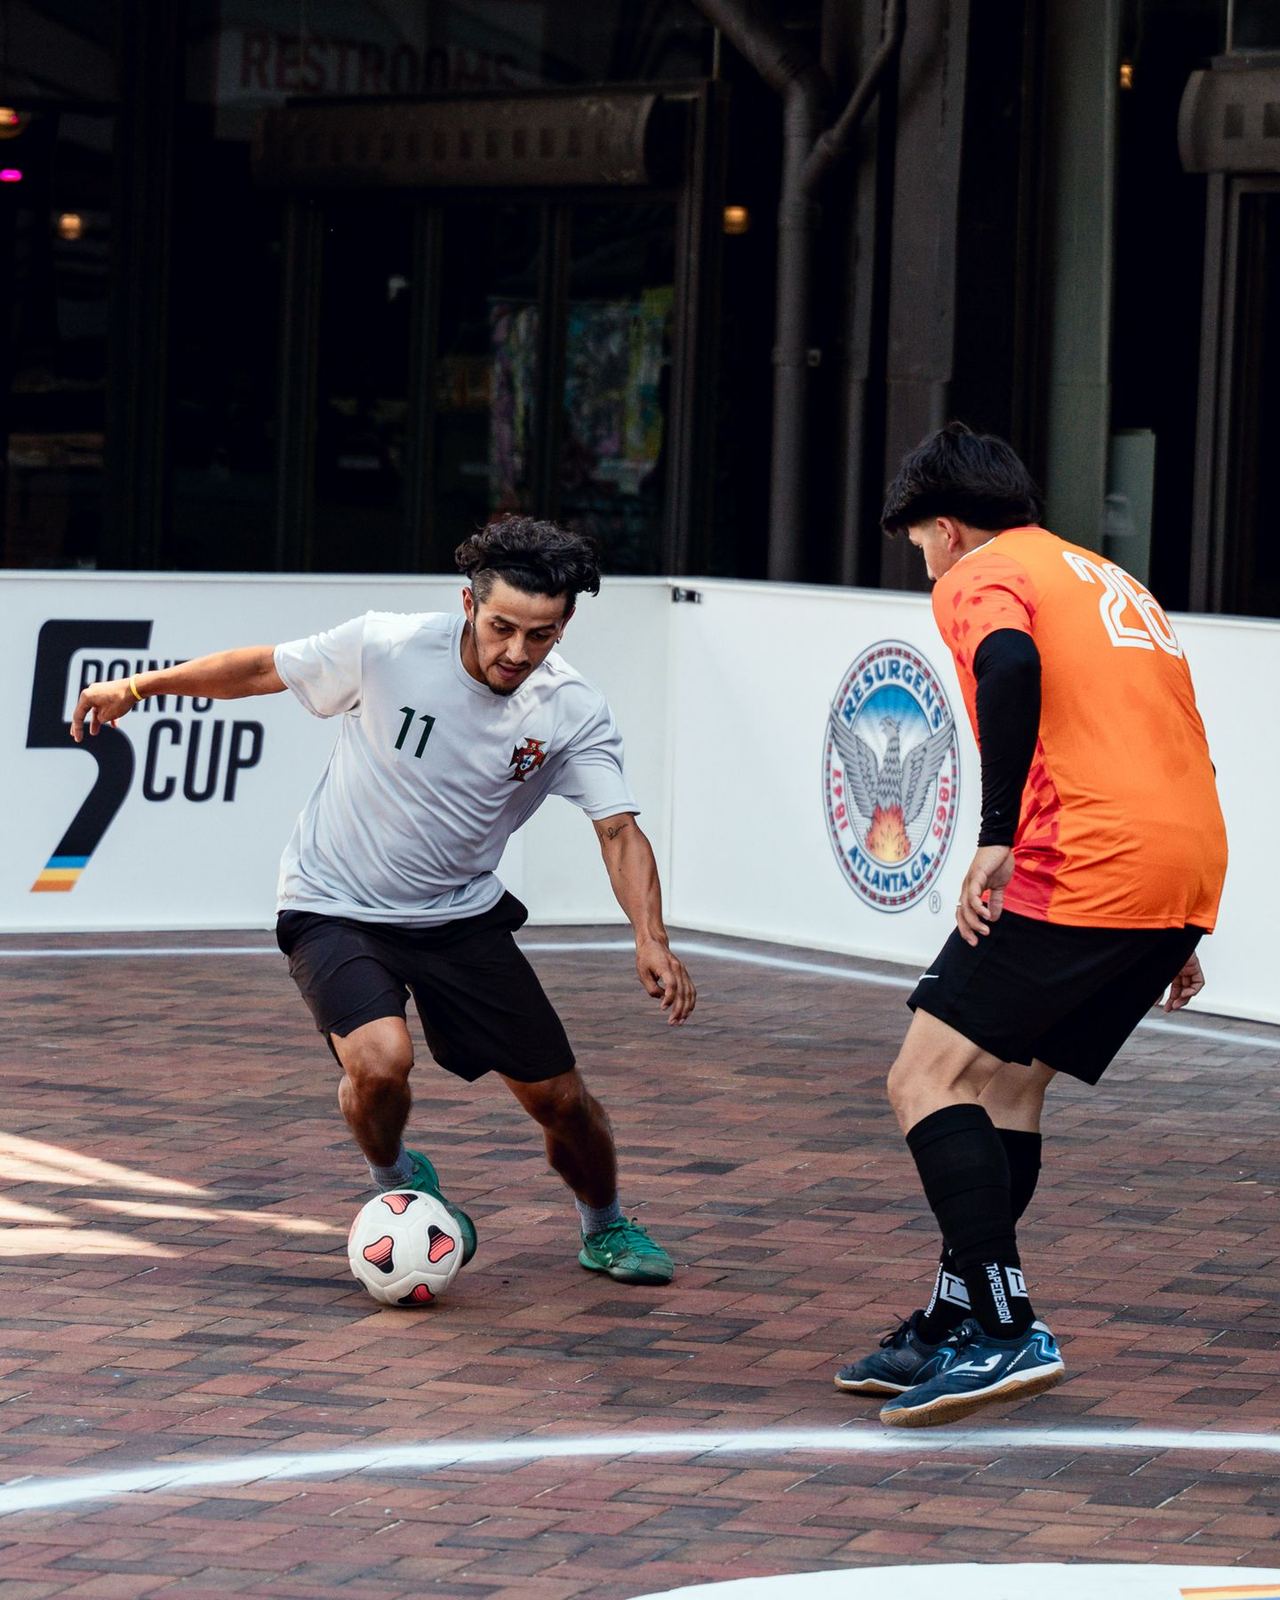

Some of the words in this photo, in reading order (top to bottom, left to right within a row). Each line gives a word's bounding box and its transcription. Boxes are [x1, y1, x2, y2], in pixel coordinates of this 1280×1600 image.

[1062, 551, 1183, 659] 26
[842, 659, 943, 728] RESURGENS
[26, 619, 154, 892] 5
[143, 718, 265, 803] CUP
[395, 706, 436, 759] 11
[832, 769, 849, 832] 1847
[932, 776, 950, 839] 1865
[985, 1262, 1014, 1324] TAPEDESIGN
